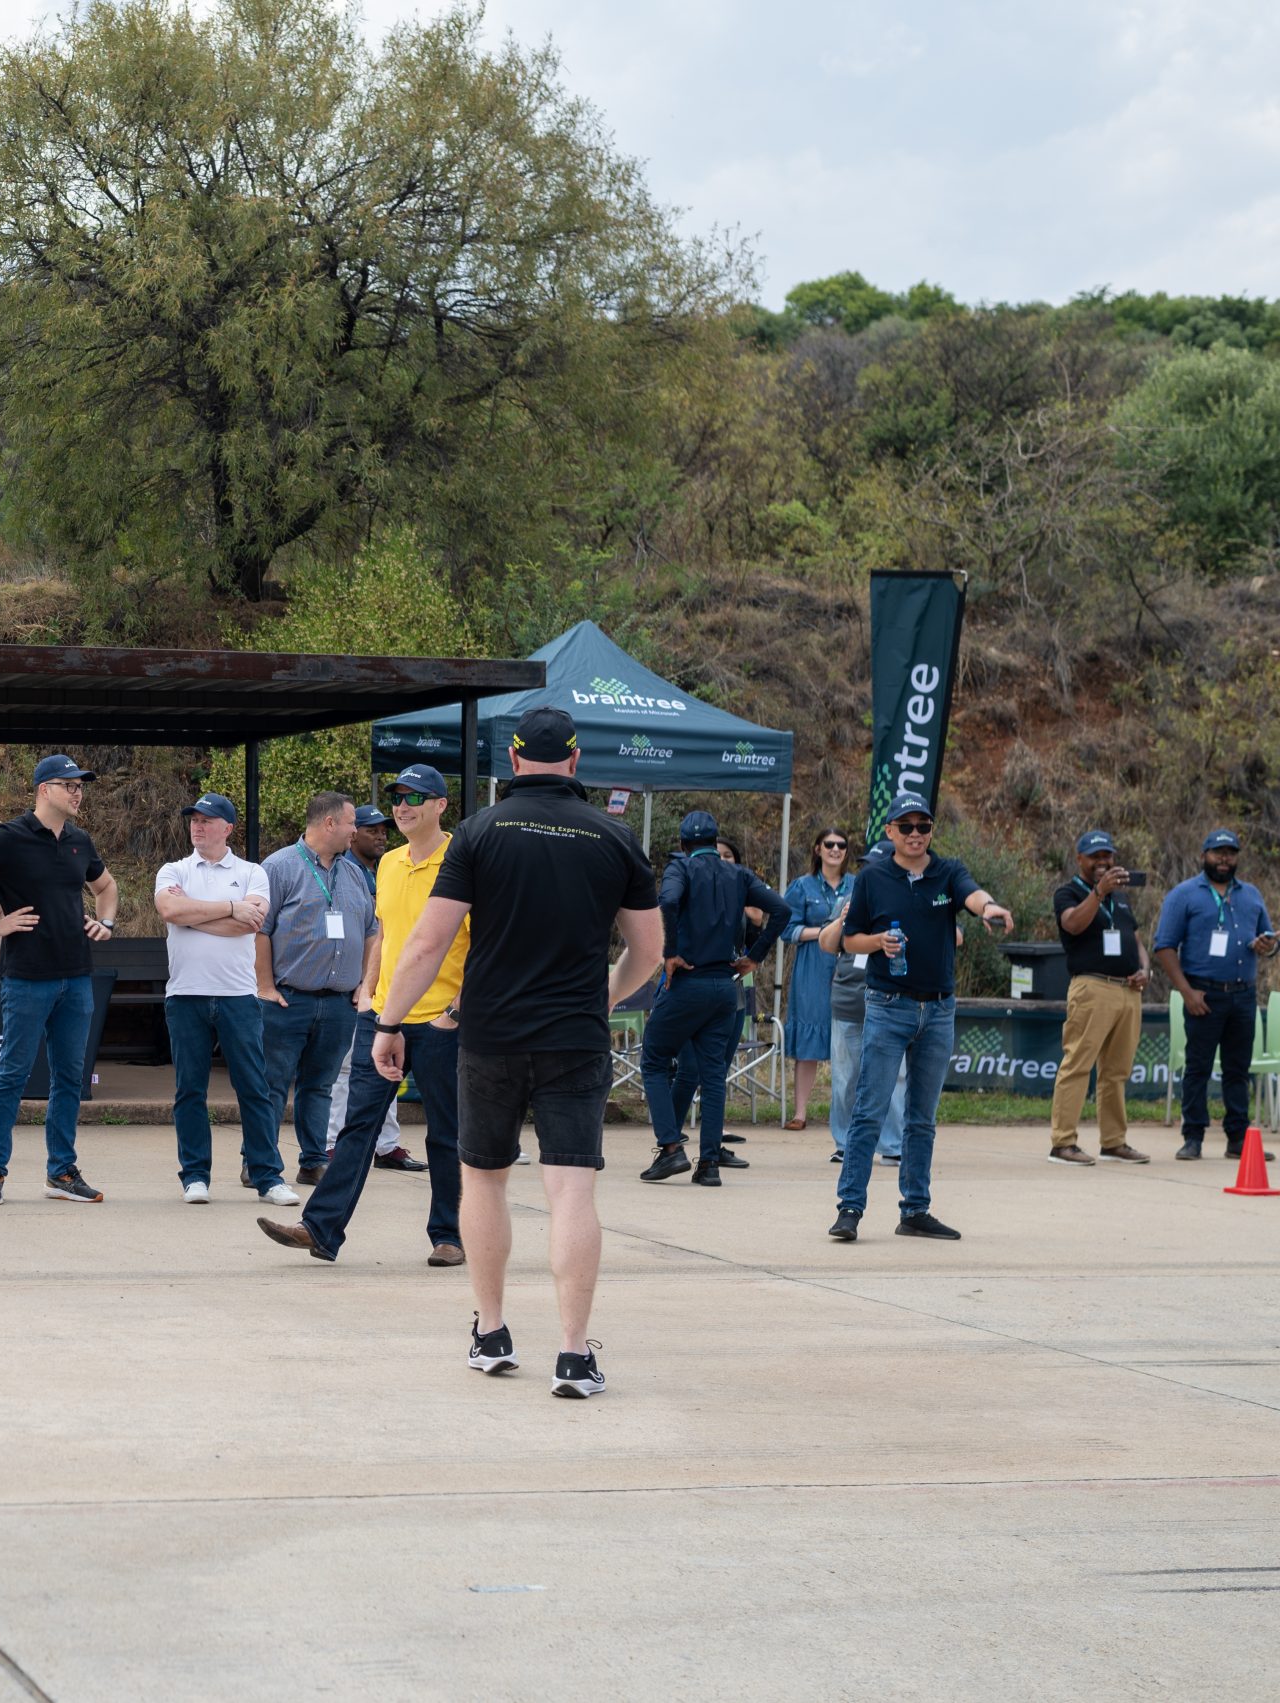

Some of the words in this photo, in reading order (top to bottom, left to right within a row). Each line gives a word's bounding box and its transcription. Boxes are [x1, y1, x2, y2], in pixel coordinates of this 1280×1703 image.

[571, 689, 687, 711] braintree
[618, 743, 673, 758] braintree
[721, 750, 776, 766] braintree
[529, 822, 556, 832] Driving
[558, 826, 601, 839] Experiences
[950, 1052, 1058, 1079] aintree
